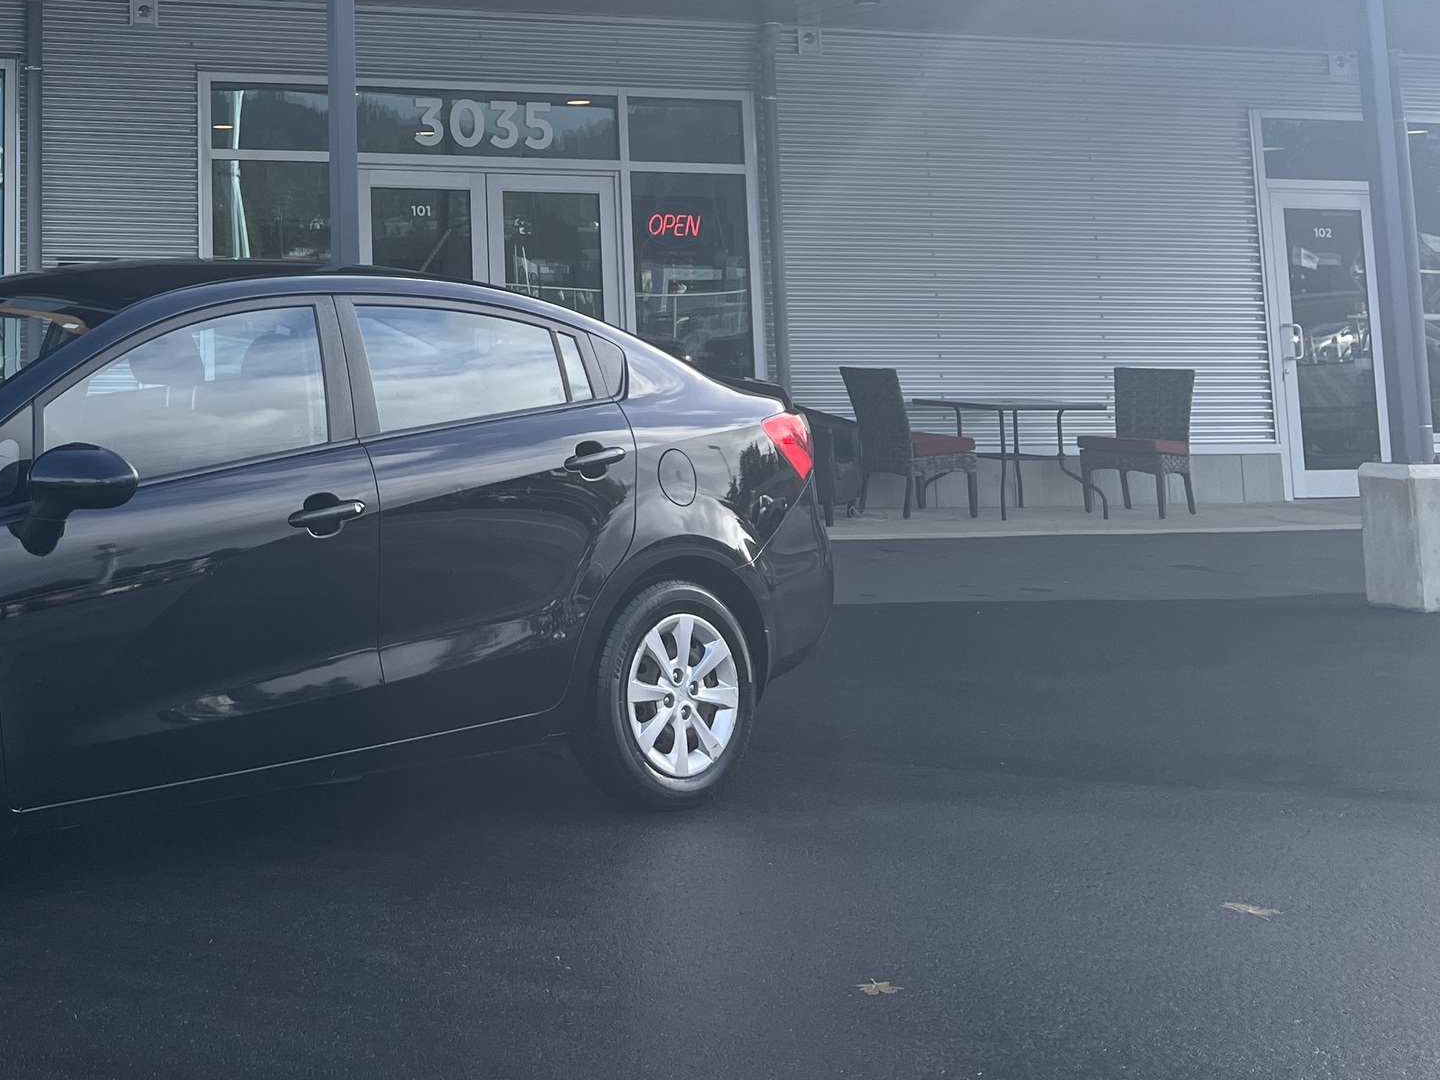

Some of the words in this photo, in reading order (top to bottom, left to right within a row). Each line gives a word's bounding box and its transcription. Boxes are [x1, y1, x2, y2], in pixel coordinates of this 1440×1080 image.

[414, 98, 554, 150] 3035
[411, 205, 431, 217] 101
[648, 213, 701, 237] OPEN
[1313, 227, 1333, 238] 102
